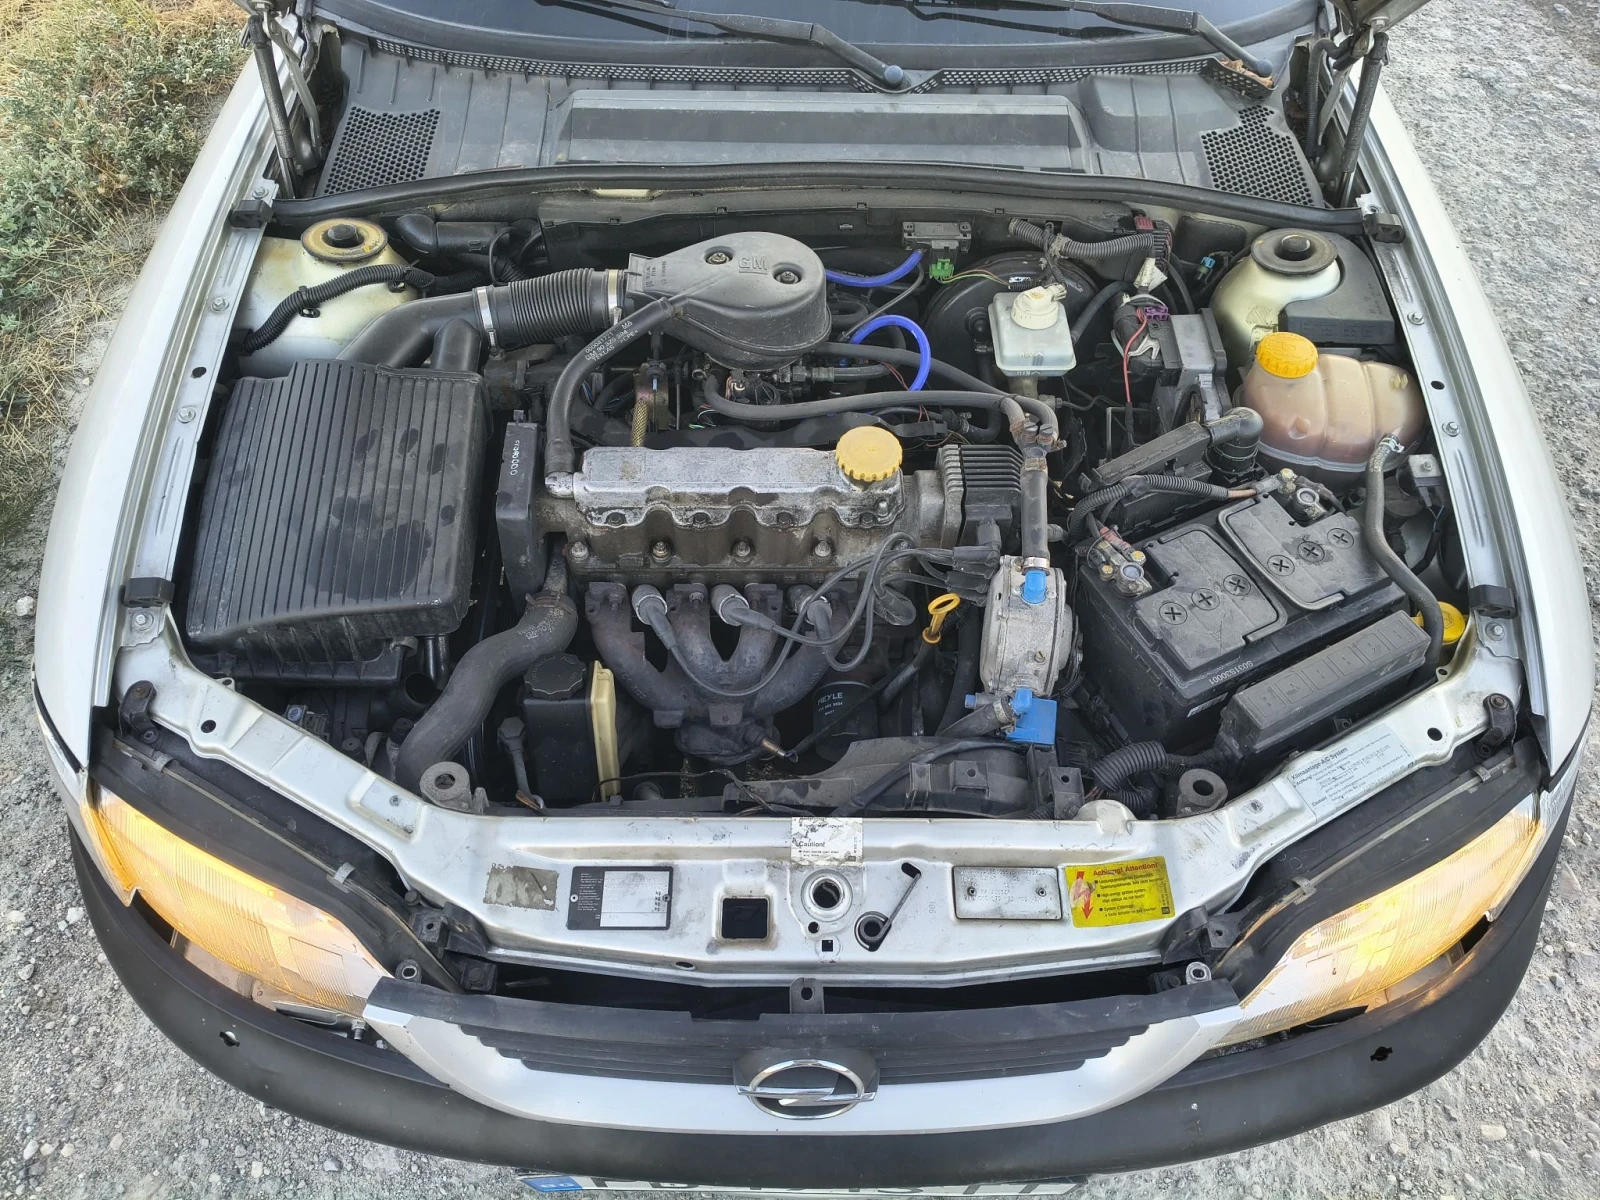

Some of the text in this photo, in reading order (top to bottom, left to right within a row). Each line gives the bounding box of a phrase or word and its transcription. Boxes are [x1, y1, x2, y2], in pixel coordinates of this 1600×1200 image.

[738, 256, 768, 271] GM
[1330, 747, 1348, 760] System
[1126, 863, 1159, 872] Attention!
